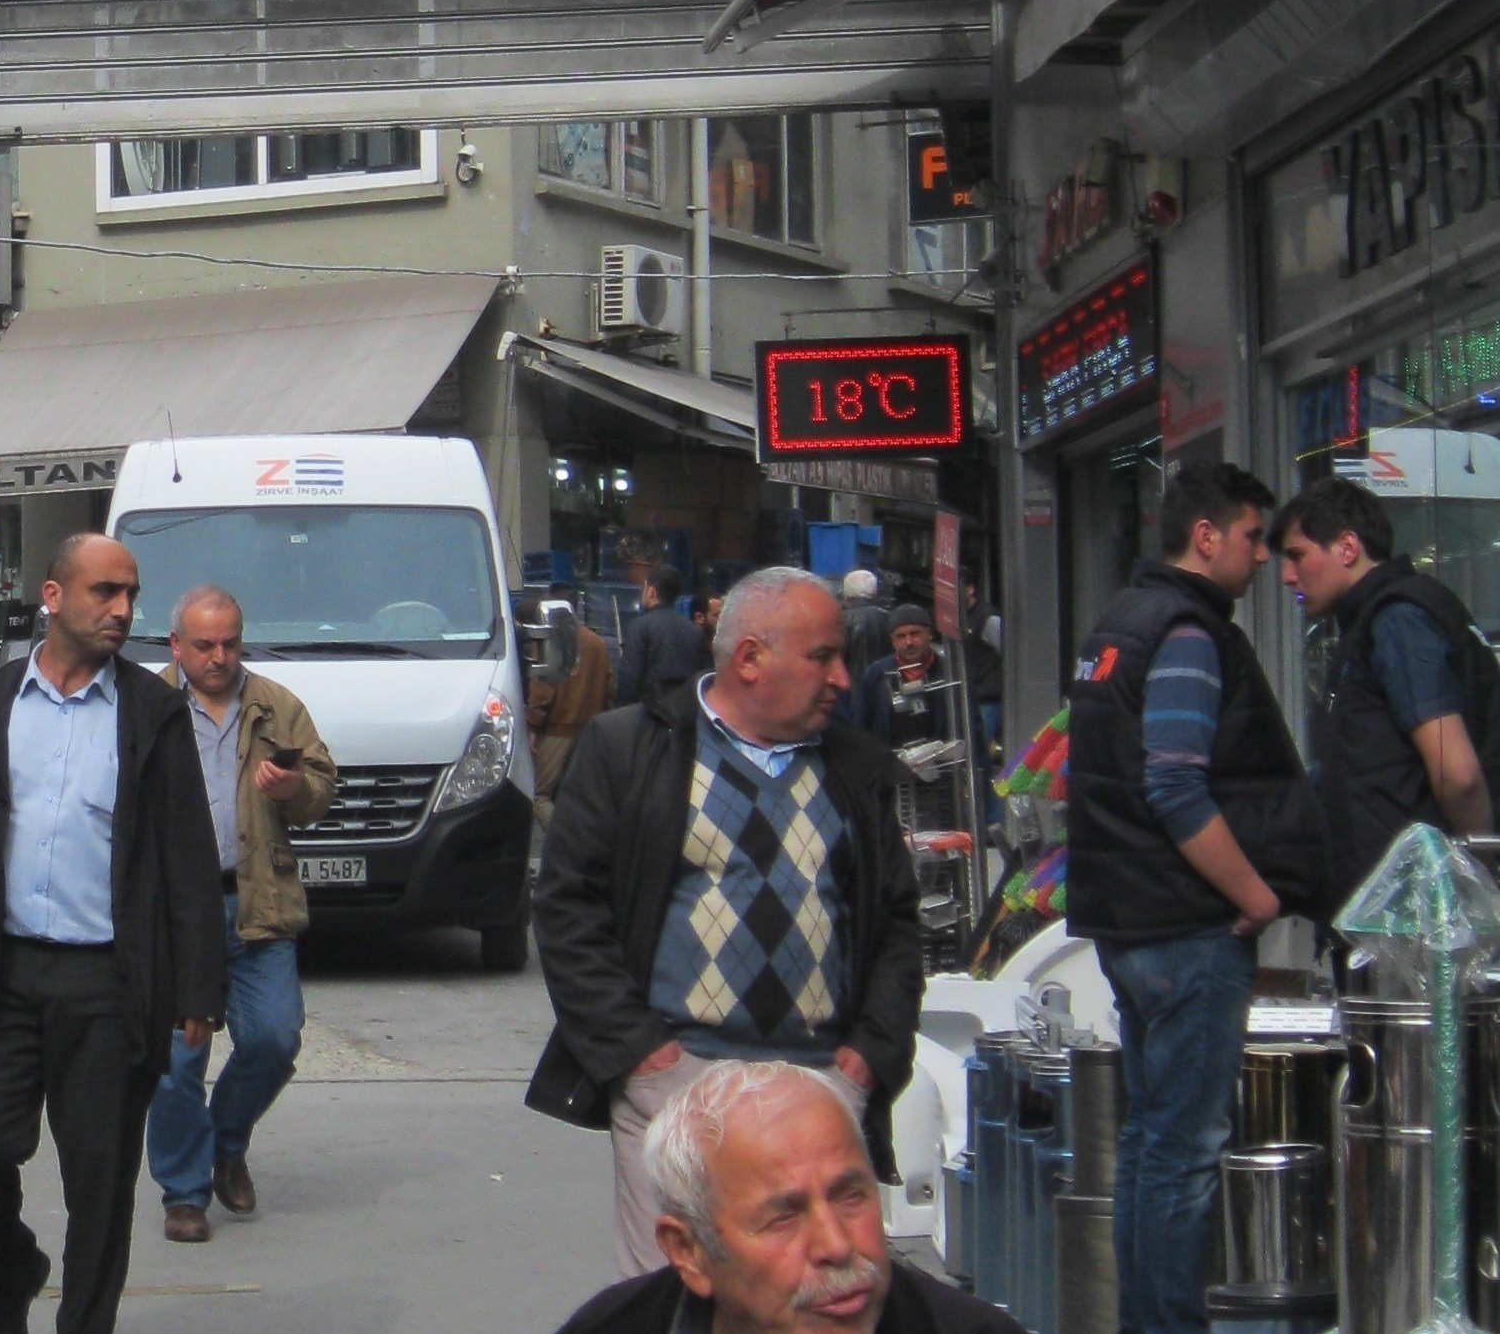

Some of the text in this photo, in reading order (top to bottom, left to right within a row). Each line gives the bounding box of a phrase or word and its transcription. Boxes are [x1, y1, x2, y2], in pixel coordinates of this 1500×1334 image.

[922, 146, 948, 189] F
[256, 486, 294, 497] ZİRVE
[301, 860, 364, 880] A 5487
